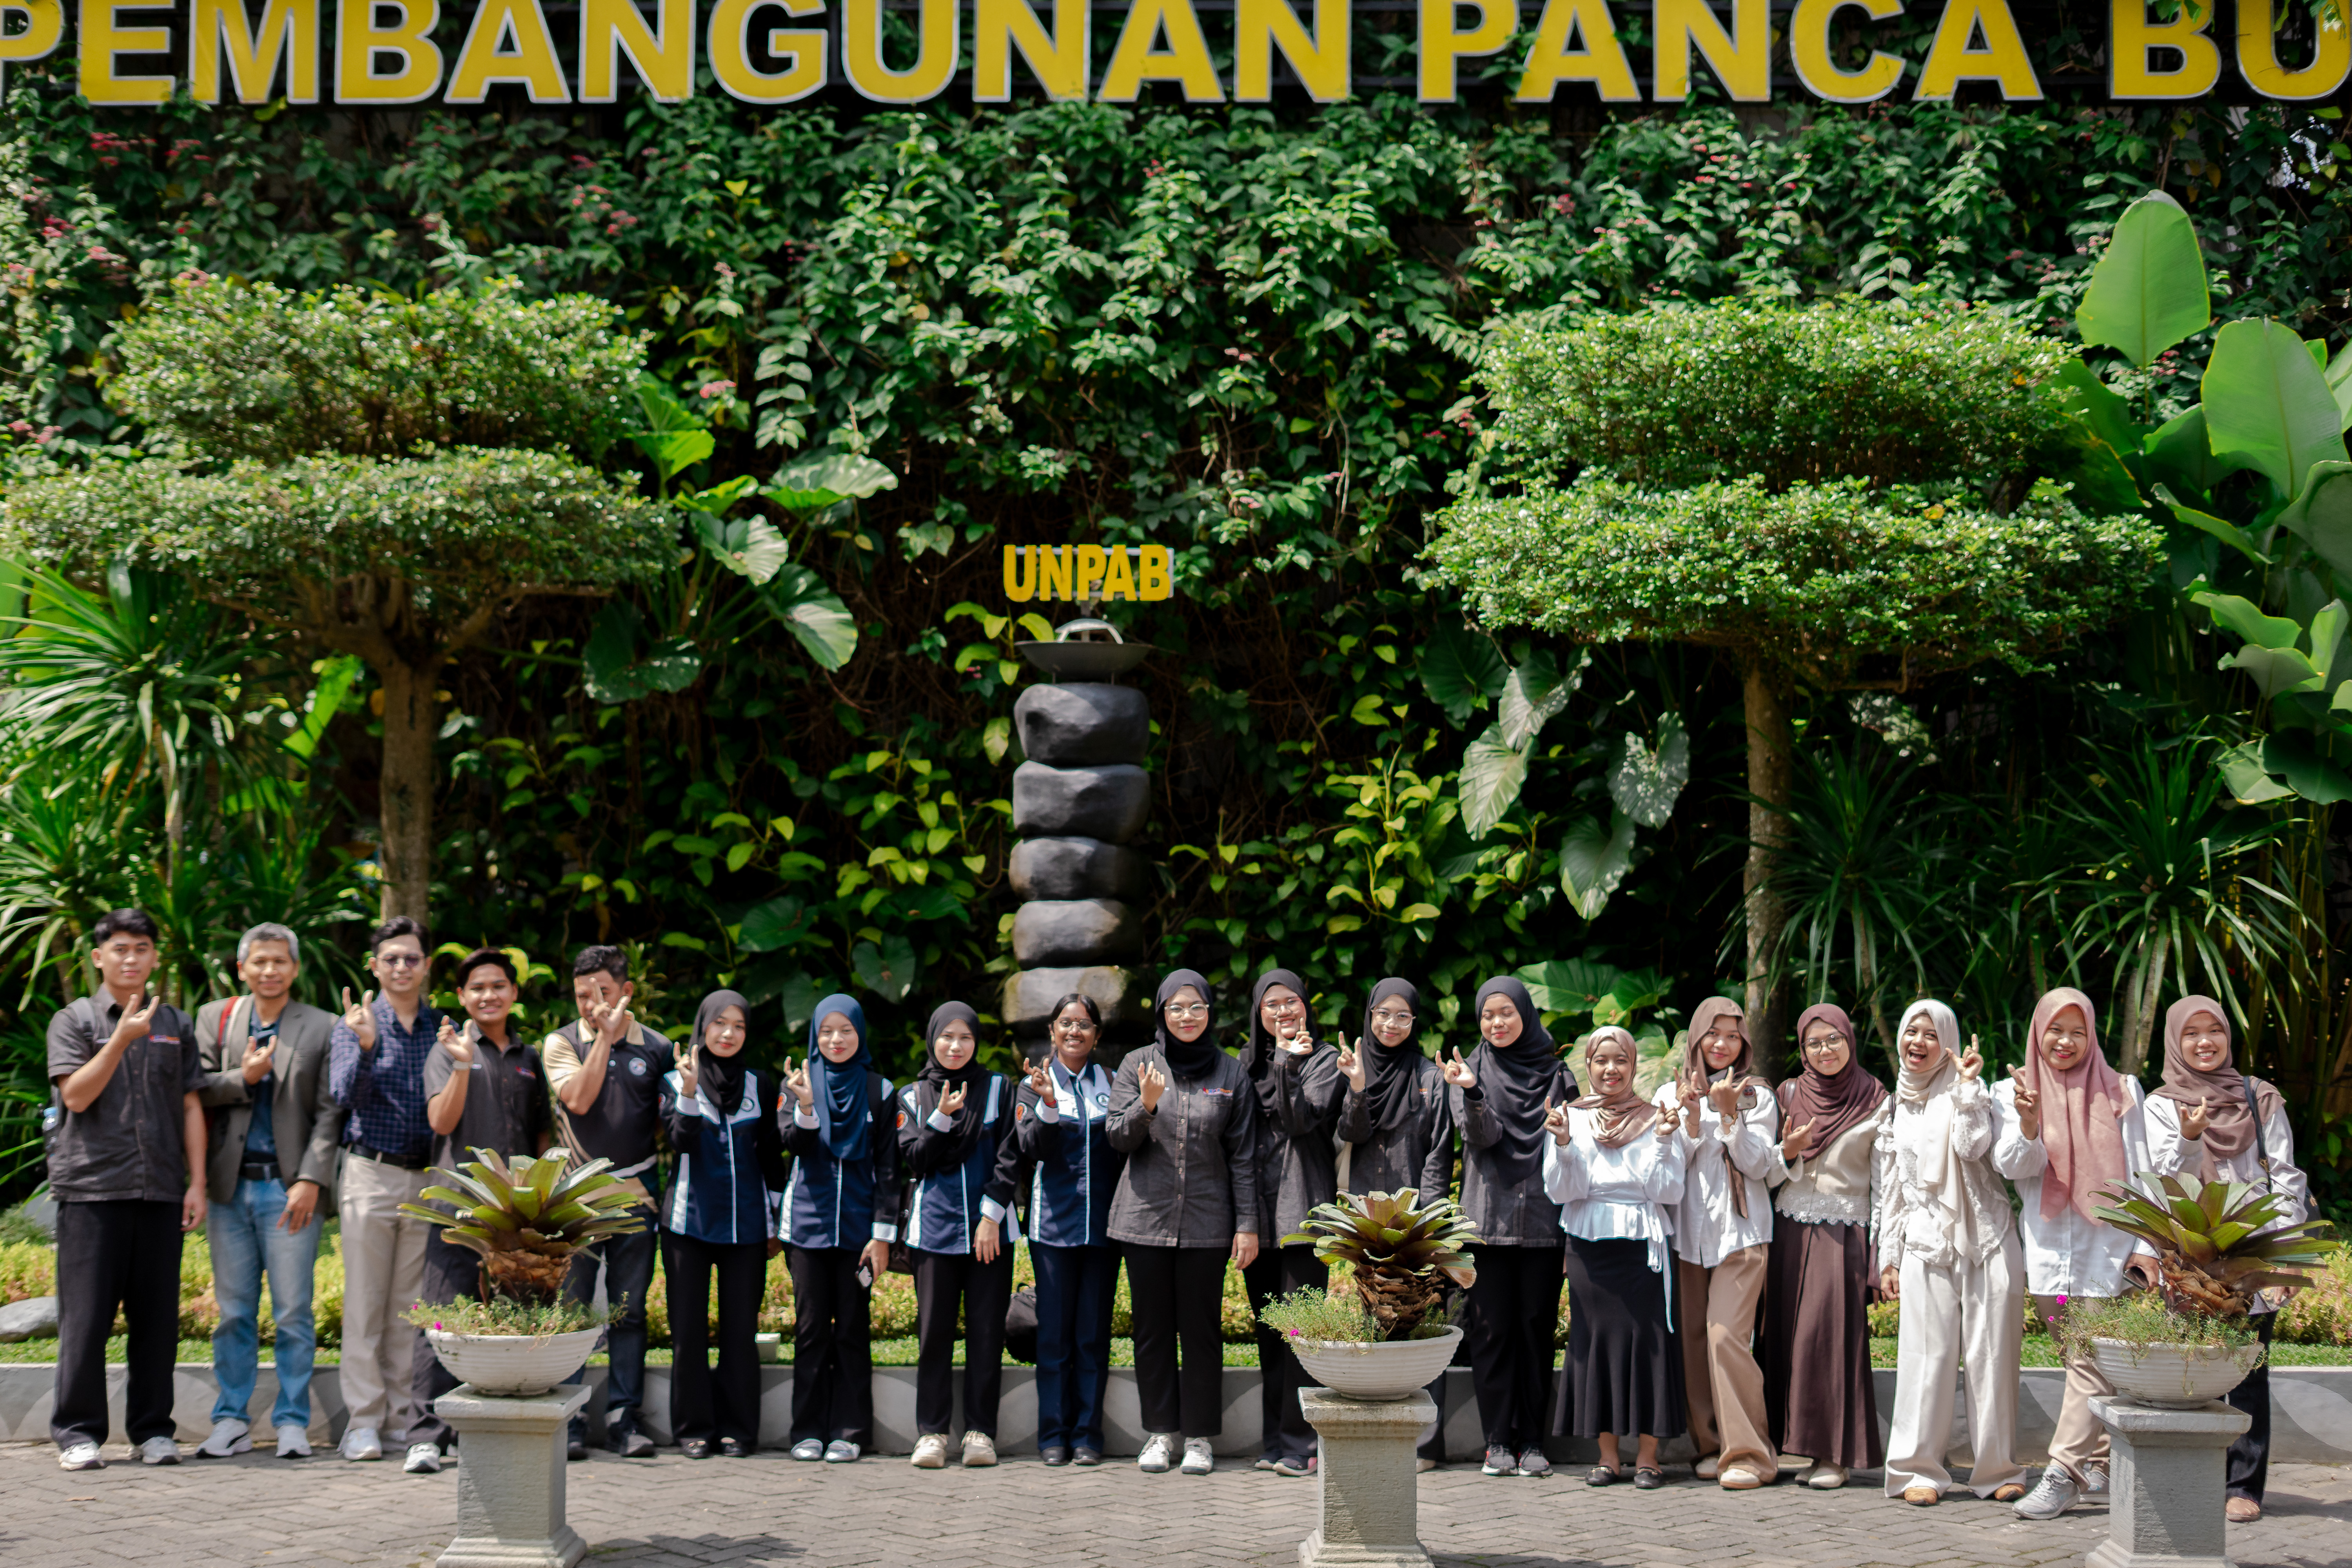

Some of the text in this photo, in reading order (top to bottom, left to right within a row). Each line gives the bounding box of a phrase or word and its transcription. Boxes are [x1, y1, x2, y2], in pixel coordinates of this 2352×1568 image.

[1417, 0, 2044, 103] PANCA
[2110, 0, 2352, 100] BU
[1004, 544, 1171, 602] UNPAB
